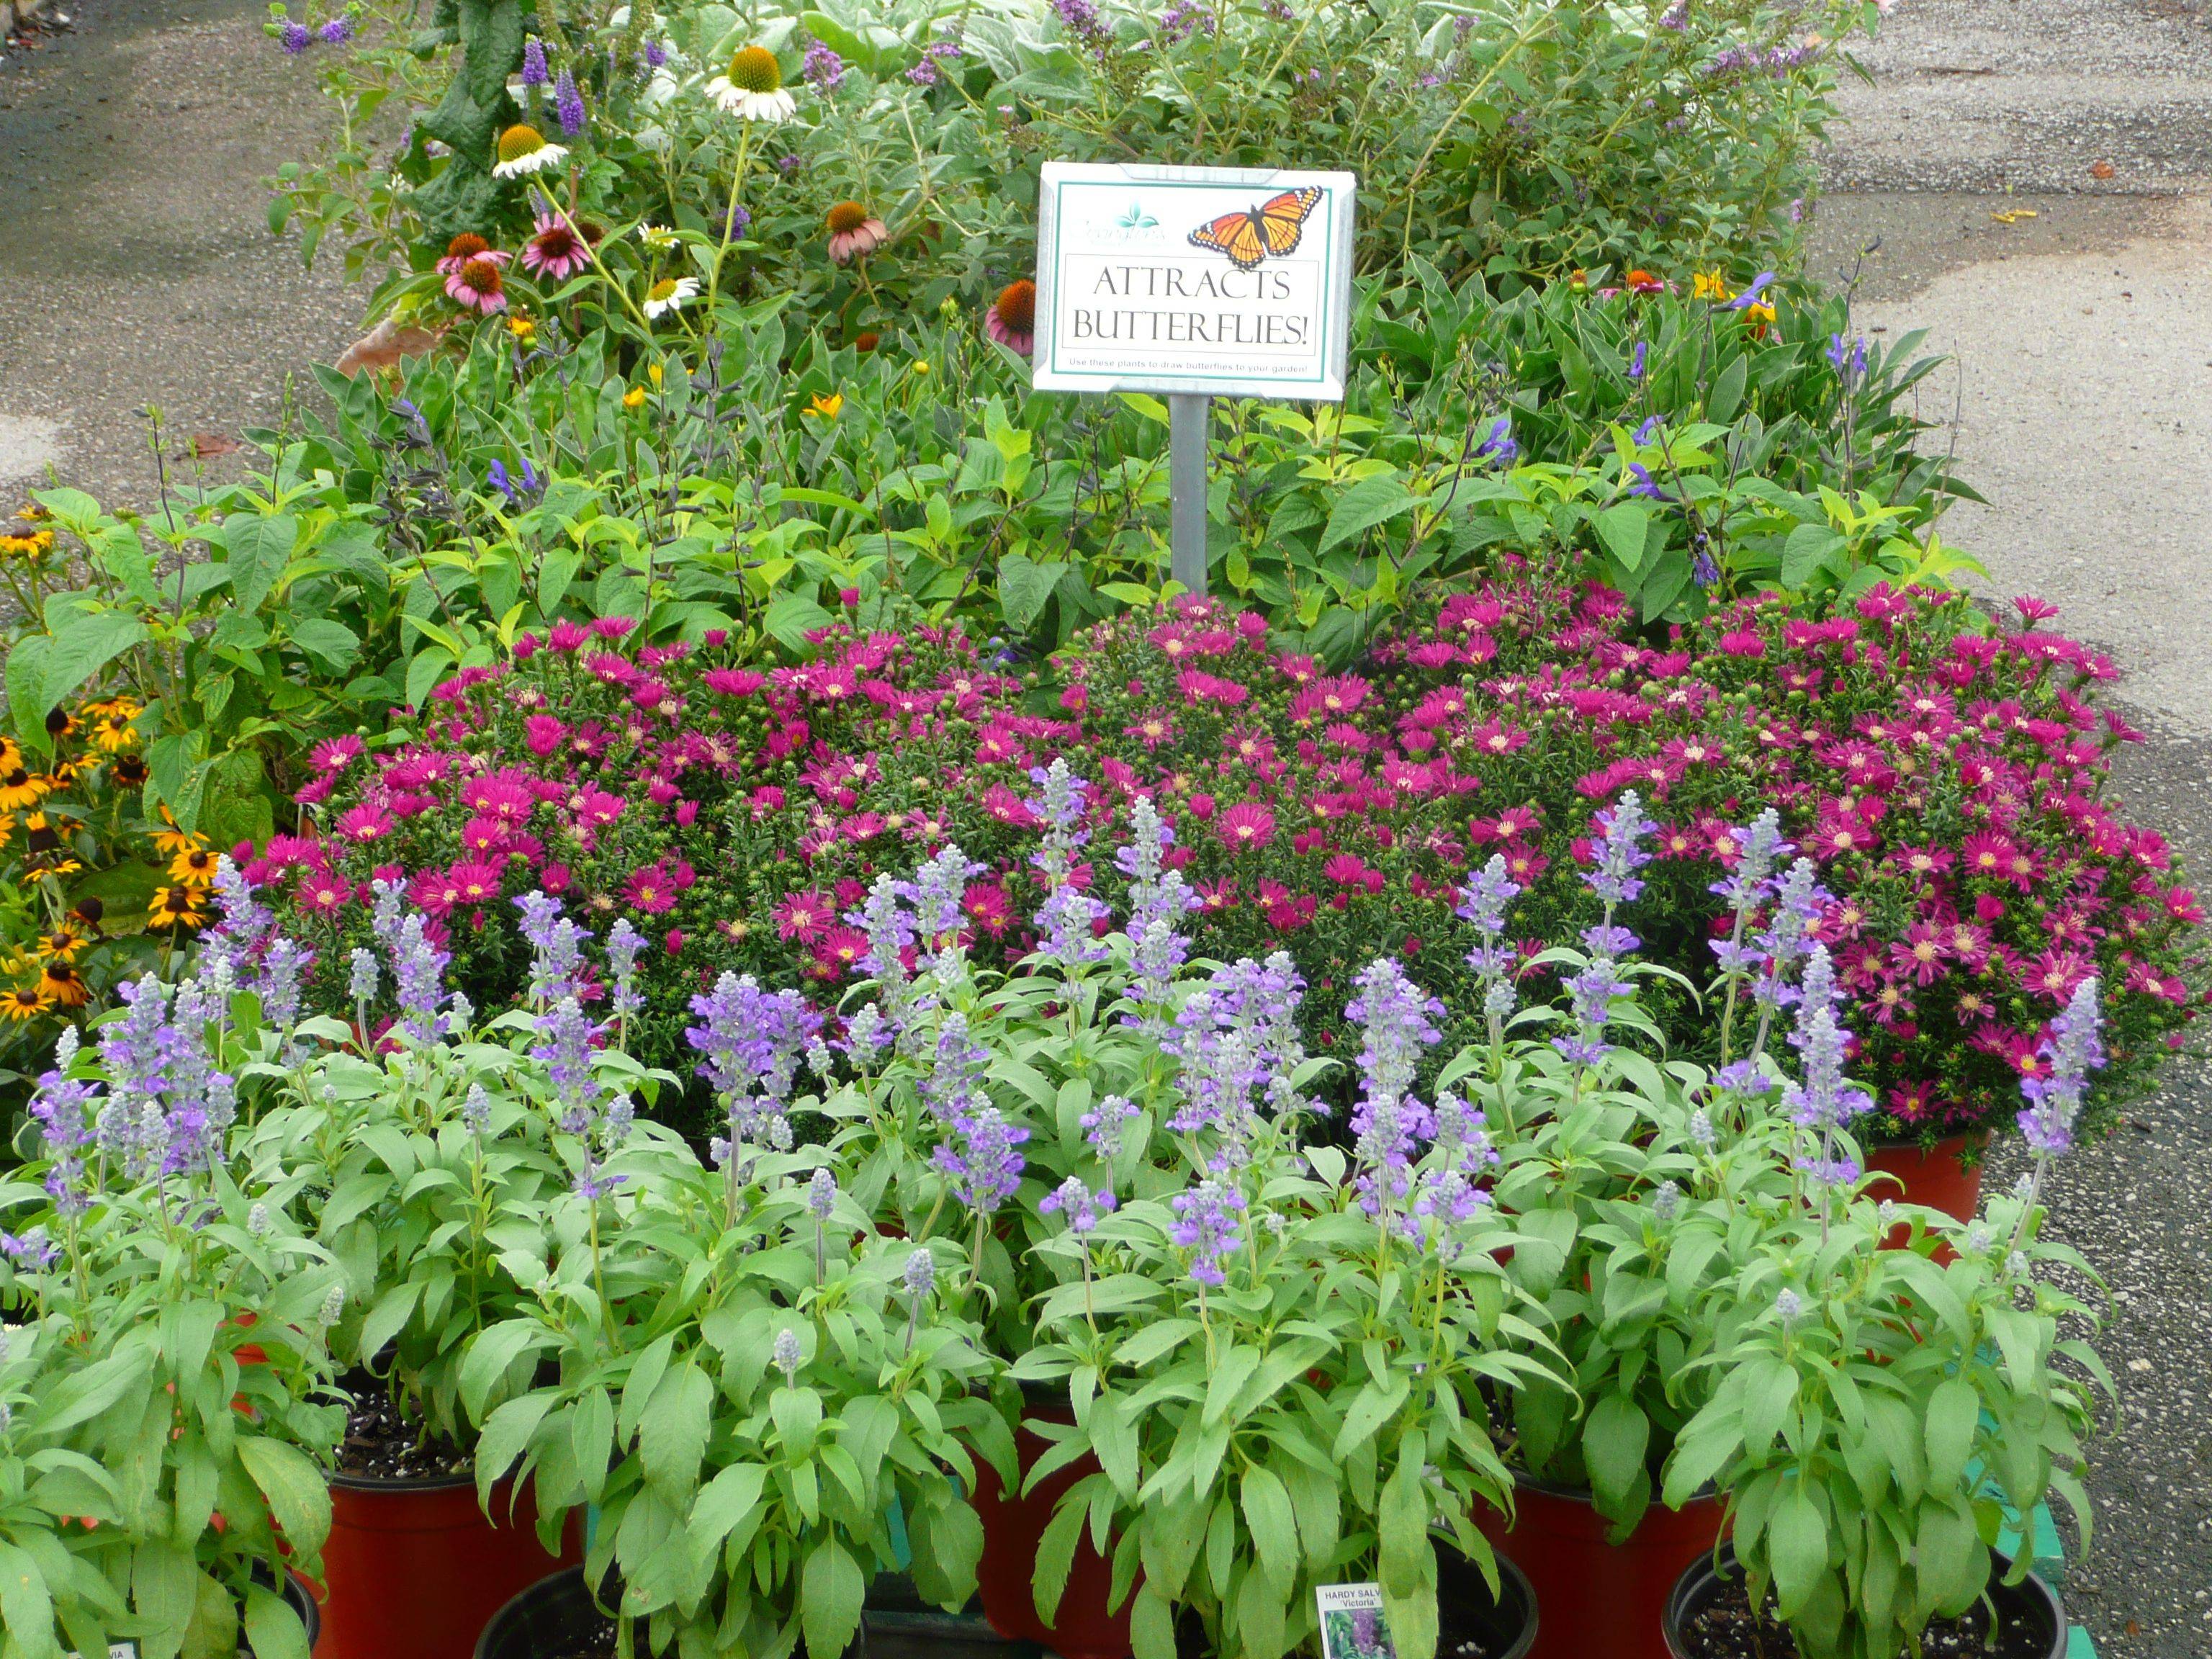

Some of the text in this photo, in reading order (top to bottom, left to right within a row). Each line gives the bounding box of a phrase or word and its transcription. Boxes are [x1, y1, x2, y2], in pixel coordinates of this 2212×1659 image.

[1092, 265, 1290, 300] ATTRACTS
[1073, 309, 1308, 345] BUTTERFLIES!
[1118, 360, 1146, 369] plants
[1186, 362, 1233, 371] butterflies
[1325, 1588, 1380, 1599] HARDY SALV
